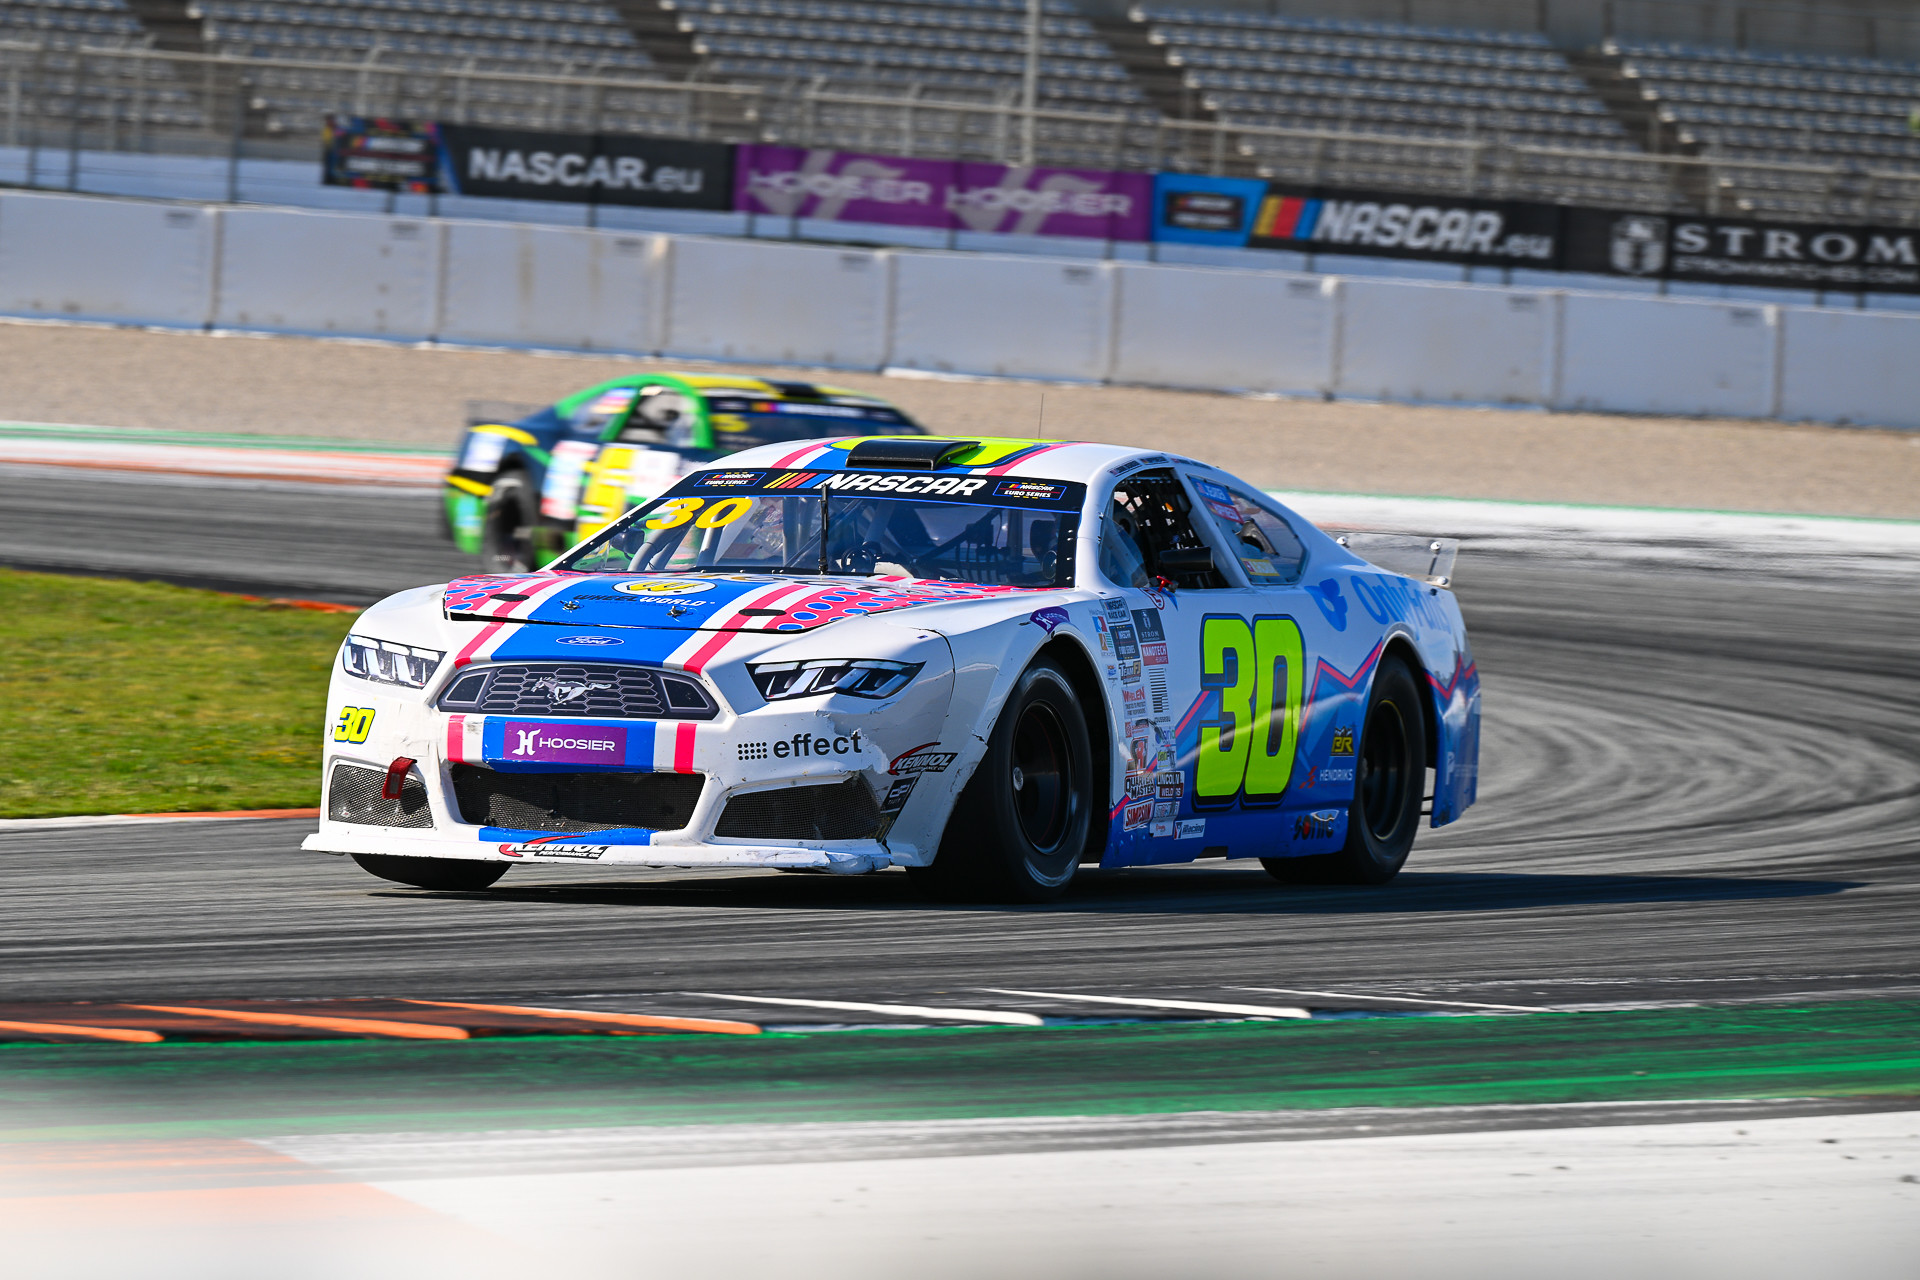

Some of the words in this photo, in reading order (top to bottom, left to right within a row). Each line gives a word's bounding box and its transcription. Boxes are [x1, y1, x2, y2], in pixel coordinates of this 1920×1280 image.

[469, 148, 703, 193] NASCAR.eu
[1312, 200, 1552, 259] NASCAR.eu
[1674, 222, 1917, 265] STROM
[813, 474, 987, 496] NASCAR
[645, 497, 753, 530] 30
[1194, 616, 1304, 803] 30
[334, 706, 376, 744] 30
[539, 737, 616, 752] HOOSIER
[773, 732, 862, 758] effect
[893, 753, 953, 771] KENNOL
[1319, 768, 1353, 781] HENDRIKS
[1131, 784, 1155, 799] MASTER
[1125, 803, 1152, 827] SIMPSON
[506, 843, 609, 854] KENNOL
